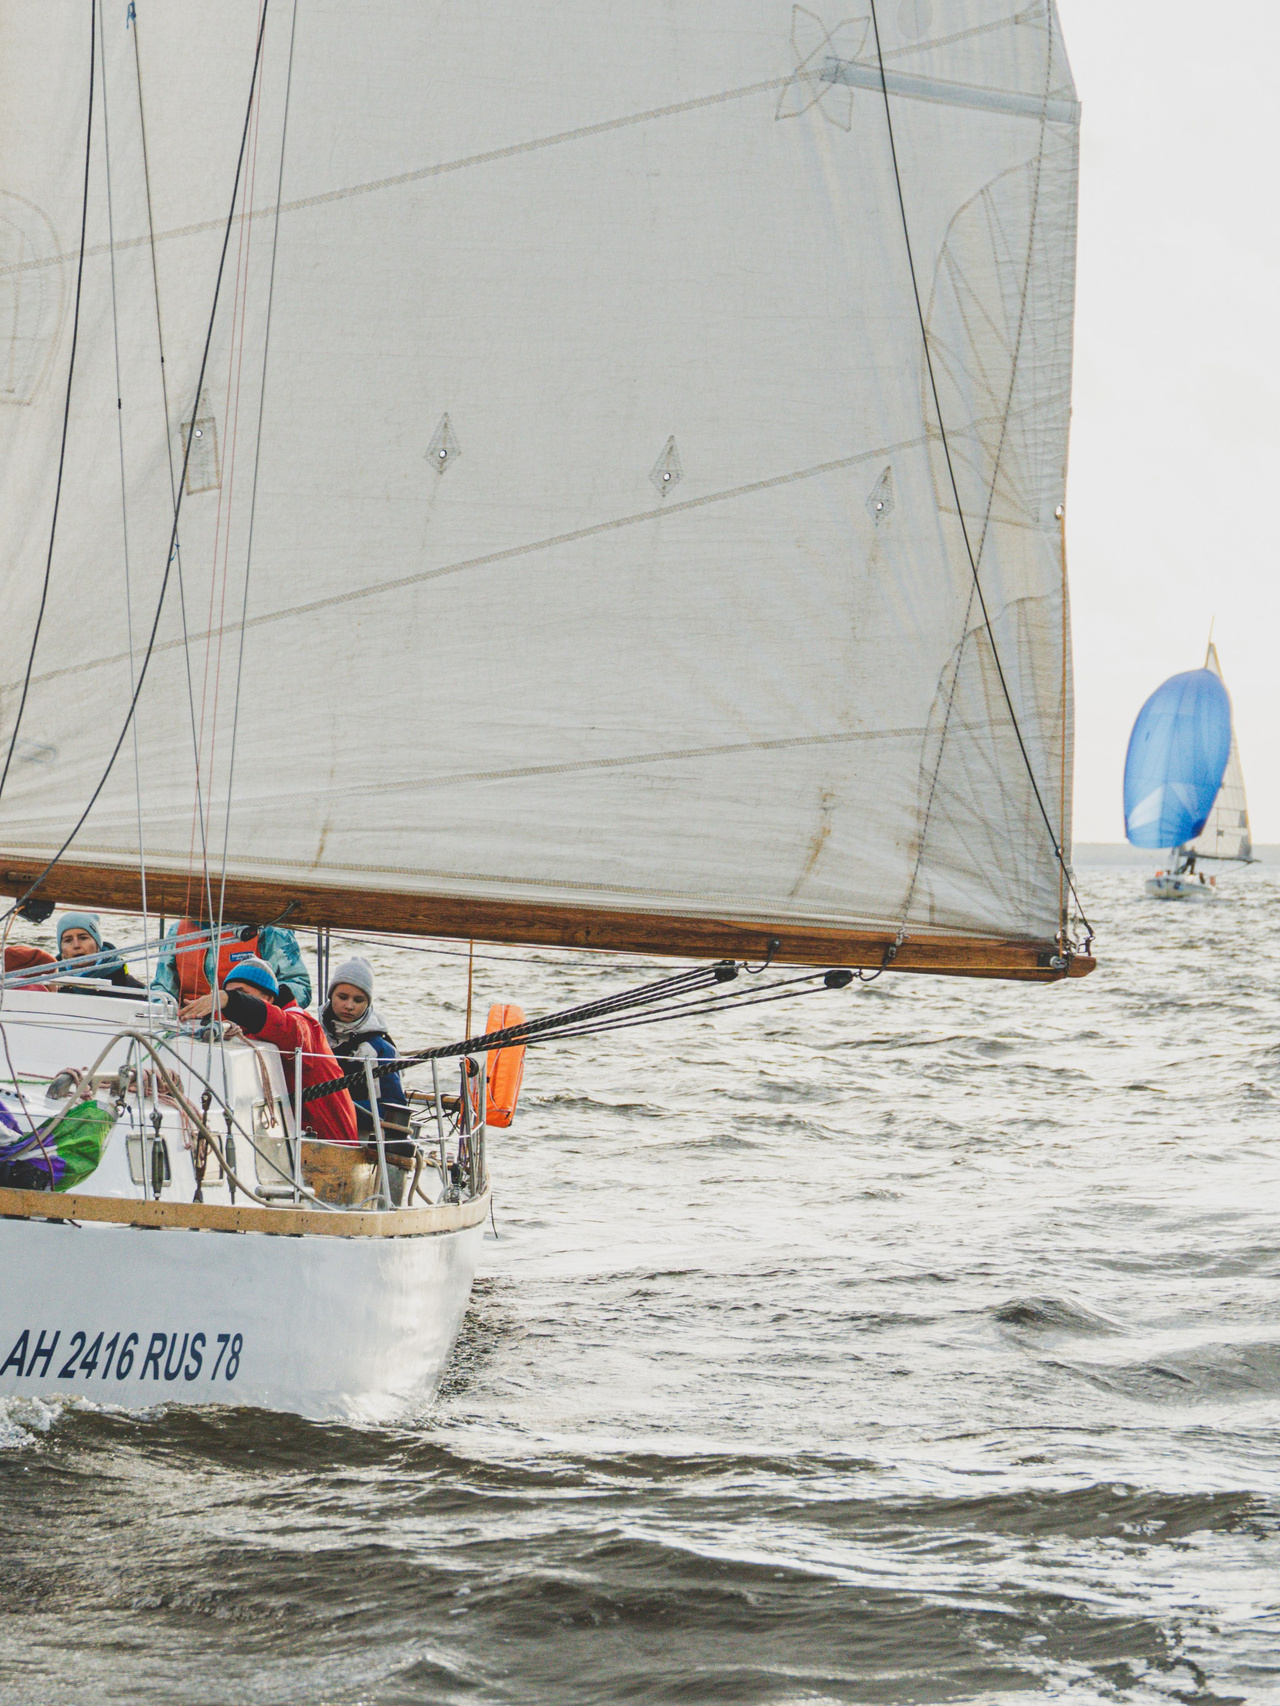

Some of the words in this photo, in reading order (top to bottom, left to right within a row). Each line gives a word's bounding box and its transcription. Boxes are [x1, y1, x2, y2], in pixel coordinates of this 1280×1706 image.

[57, 1331, 139, 1381] 2416
[139, 1332, 207, 1382] RUS
[210, 1332, 244, 1381] 78
